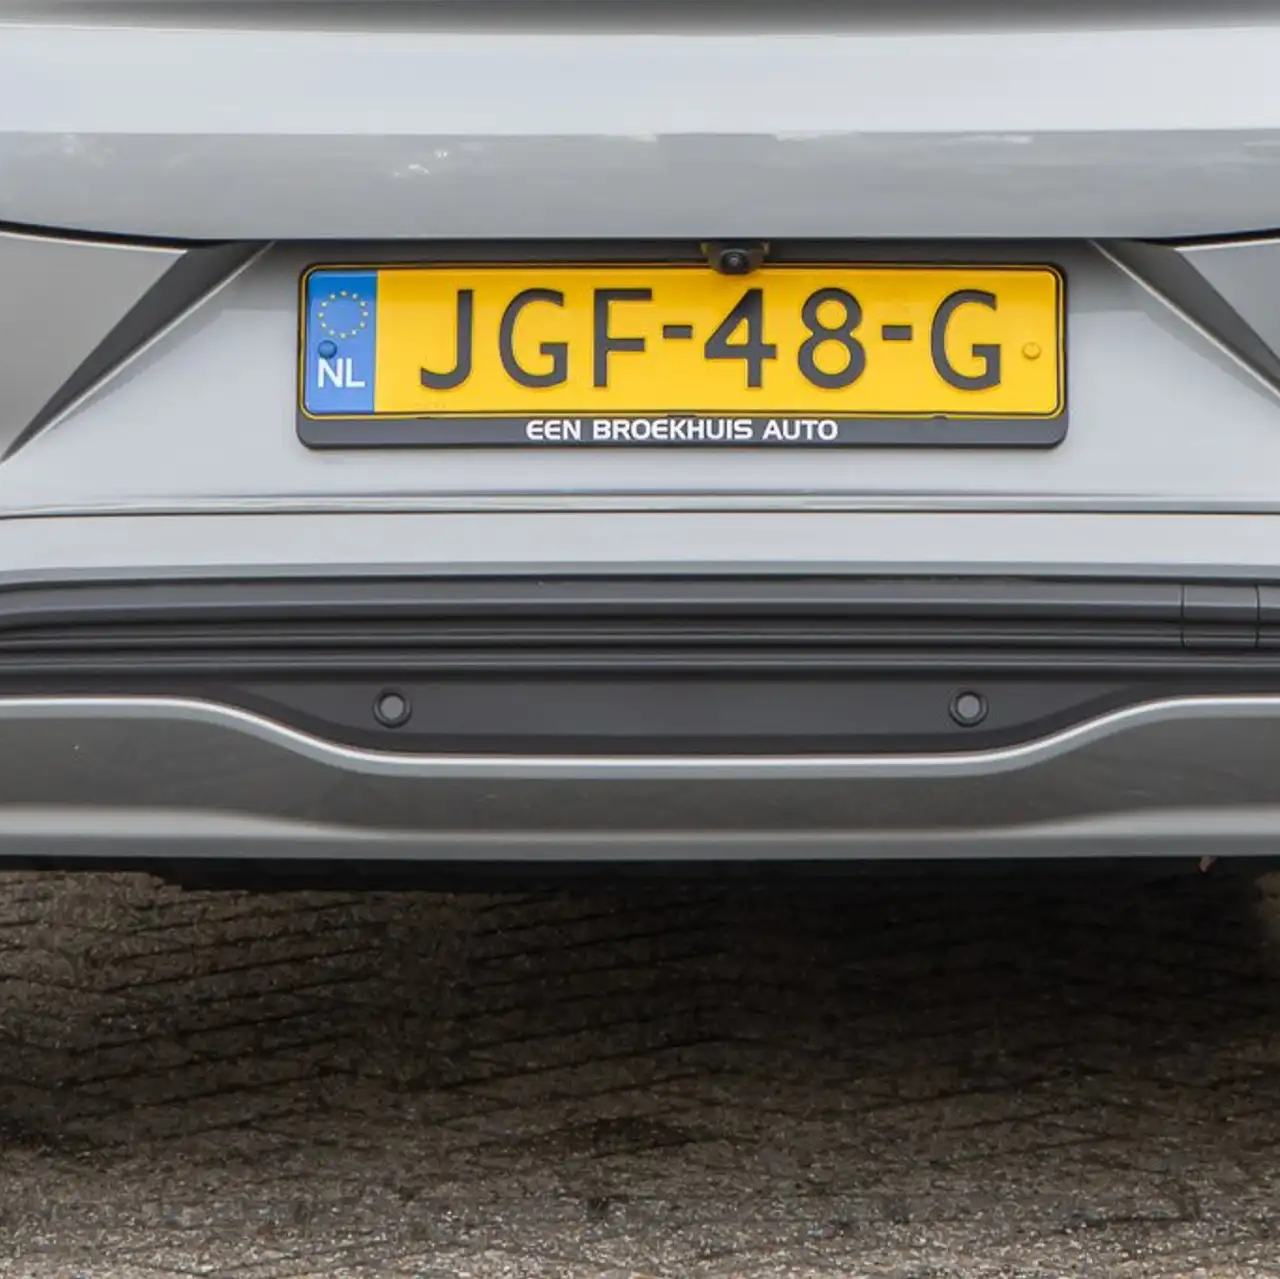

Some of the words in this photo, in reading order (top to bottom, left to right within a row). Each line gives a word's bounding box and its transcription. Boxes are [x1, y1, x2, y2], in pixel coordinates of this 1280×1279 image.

[420, 287, 1001, 391] JGF-48-G
[319, 358, 365, 388] NL
[525, 418, 581, 441] EEN
[593, 418, 752, 441] BROEKHUIS
[763, 418, 839, 441] AUTO
